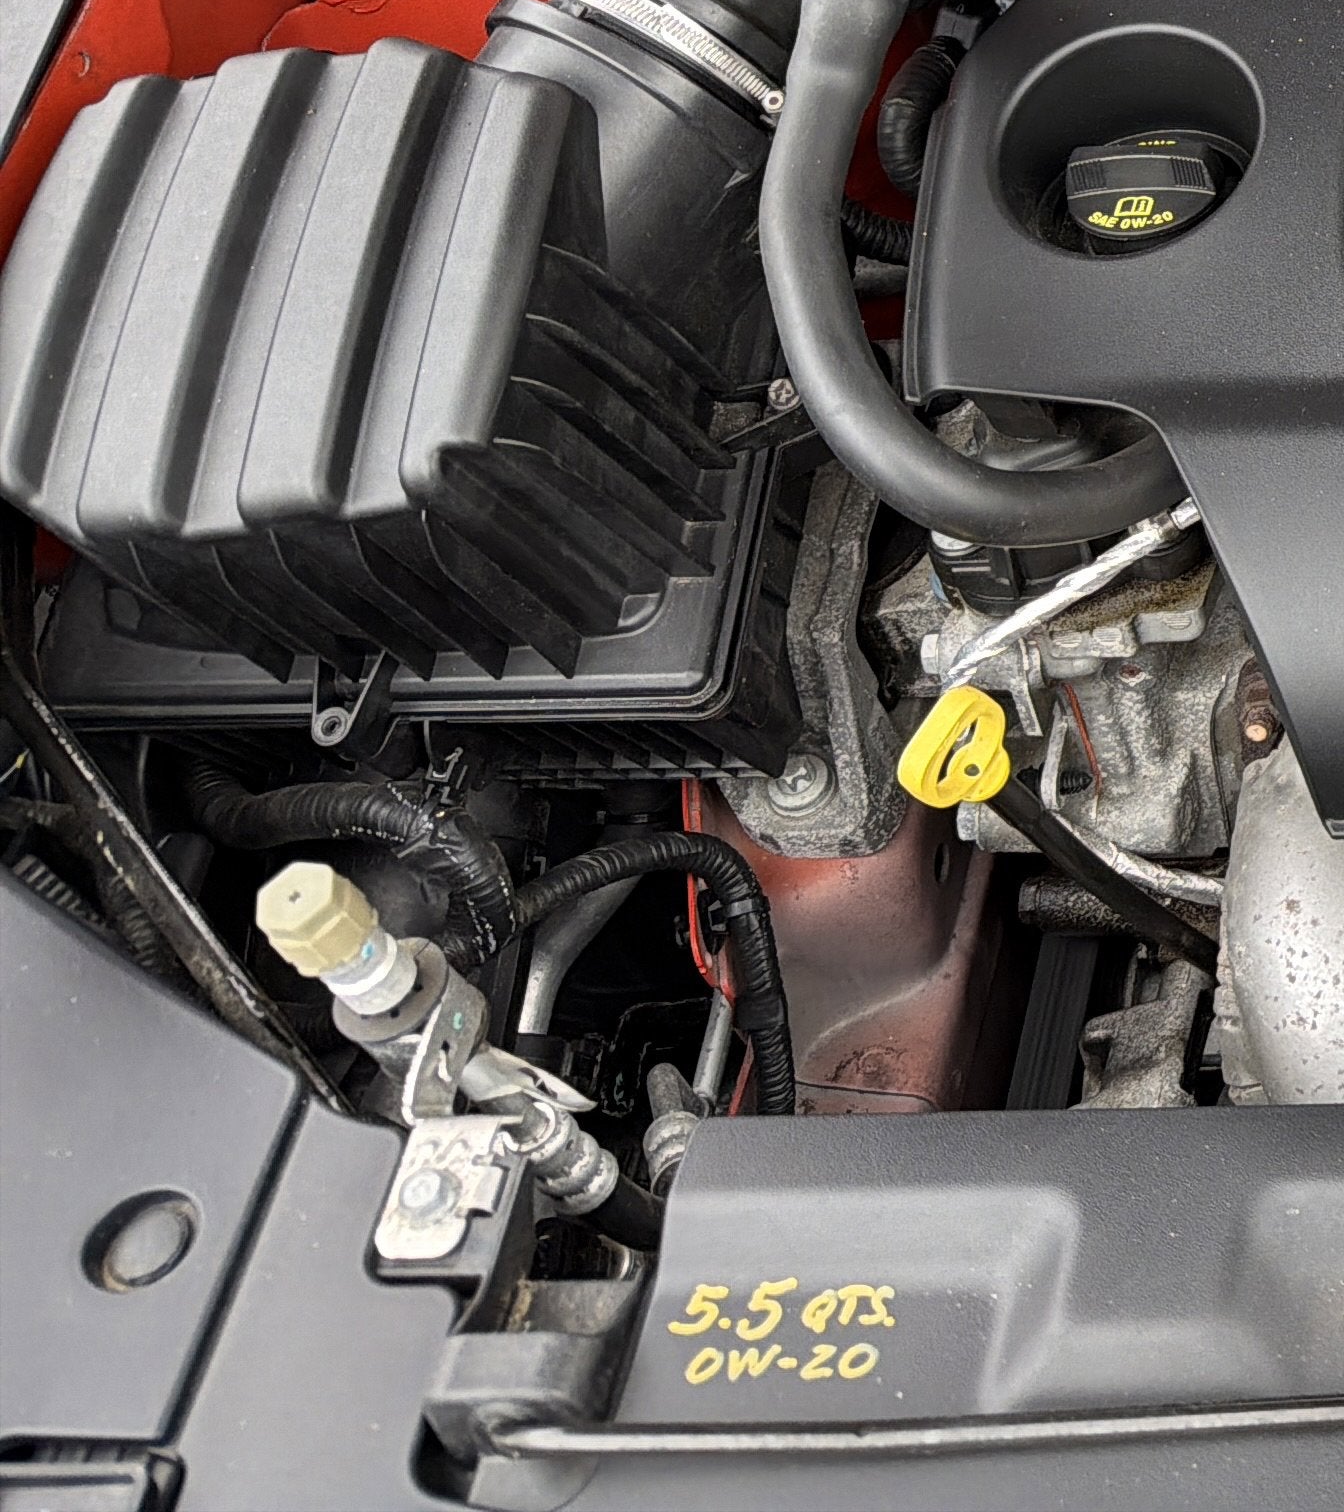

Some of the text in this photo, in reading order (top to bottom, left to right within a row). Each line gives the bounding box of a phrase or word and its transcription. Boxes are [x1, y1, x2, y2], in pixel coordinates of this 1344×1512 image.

[1088, 210, 1174, 230] SAE 0W-20
[667, 1276, 798, 1341] 5.5
[685, 1342, 880, 1385] 0W-20
